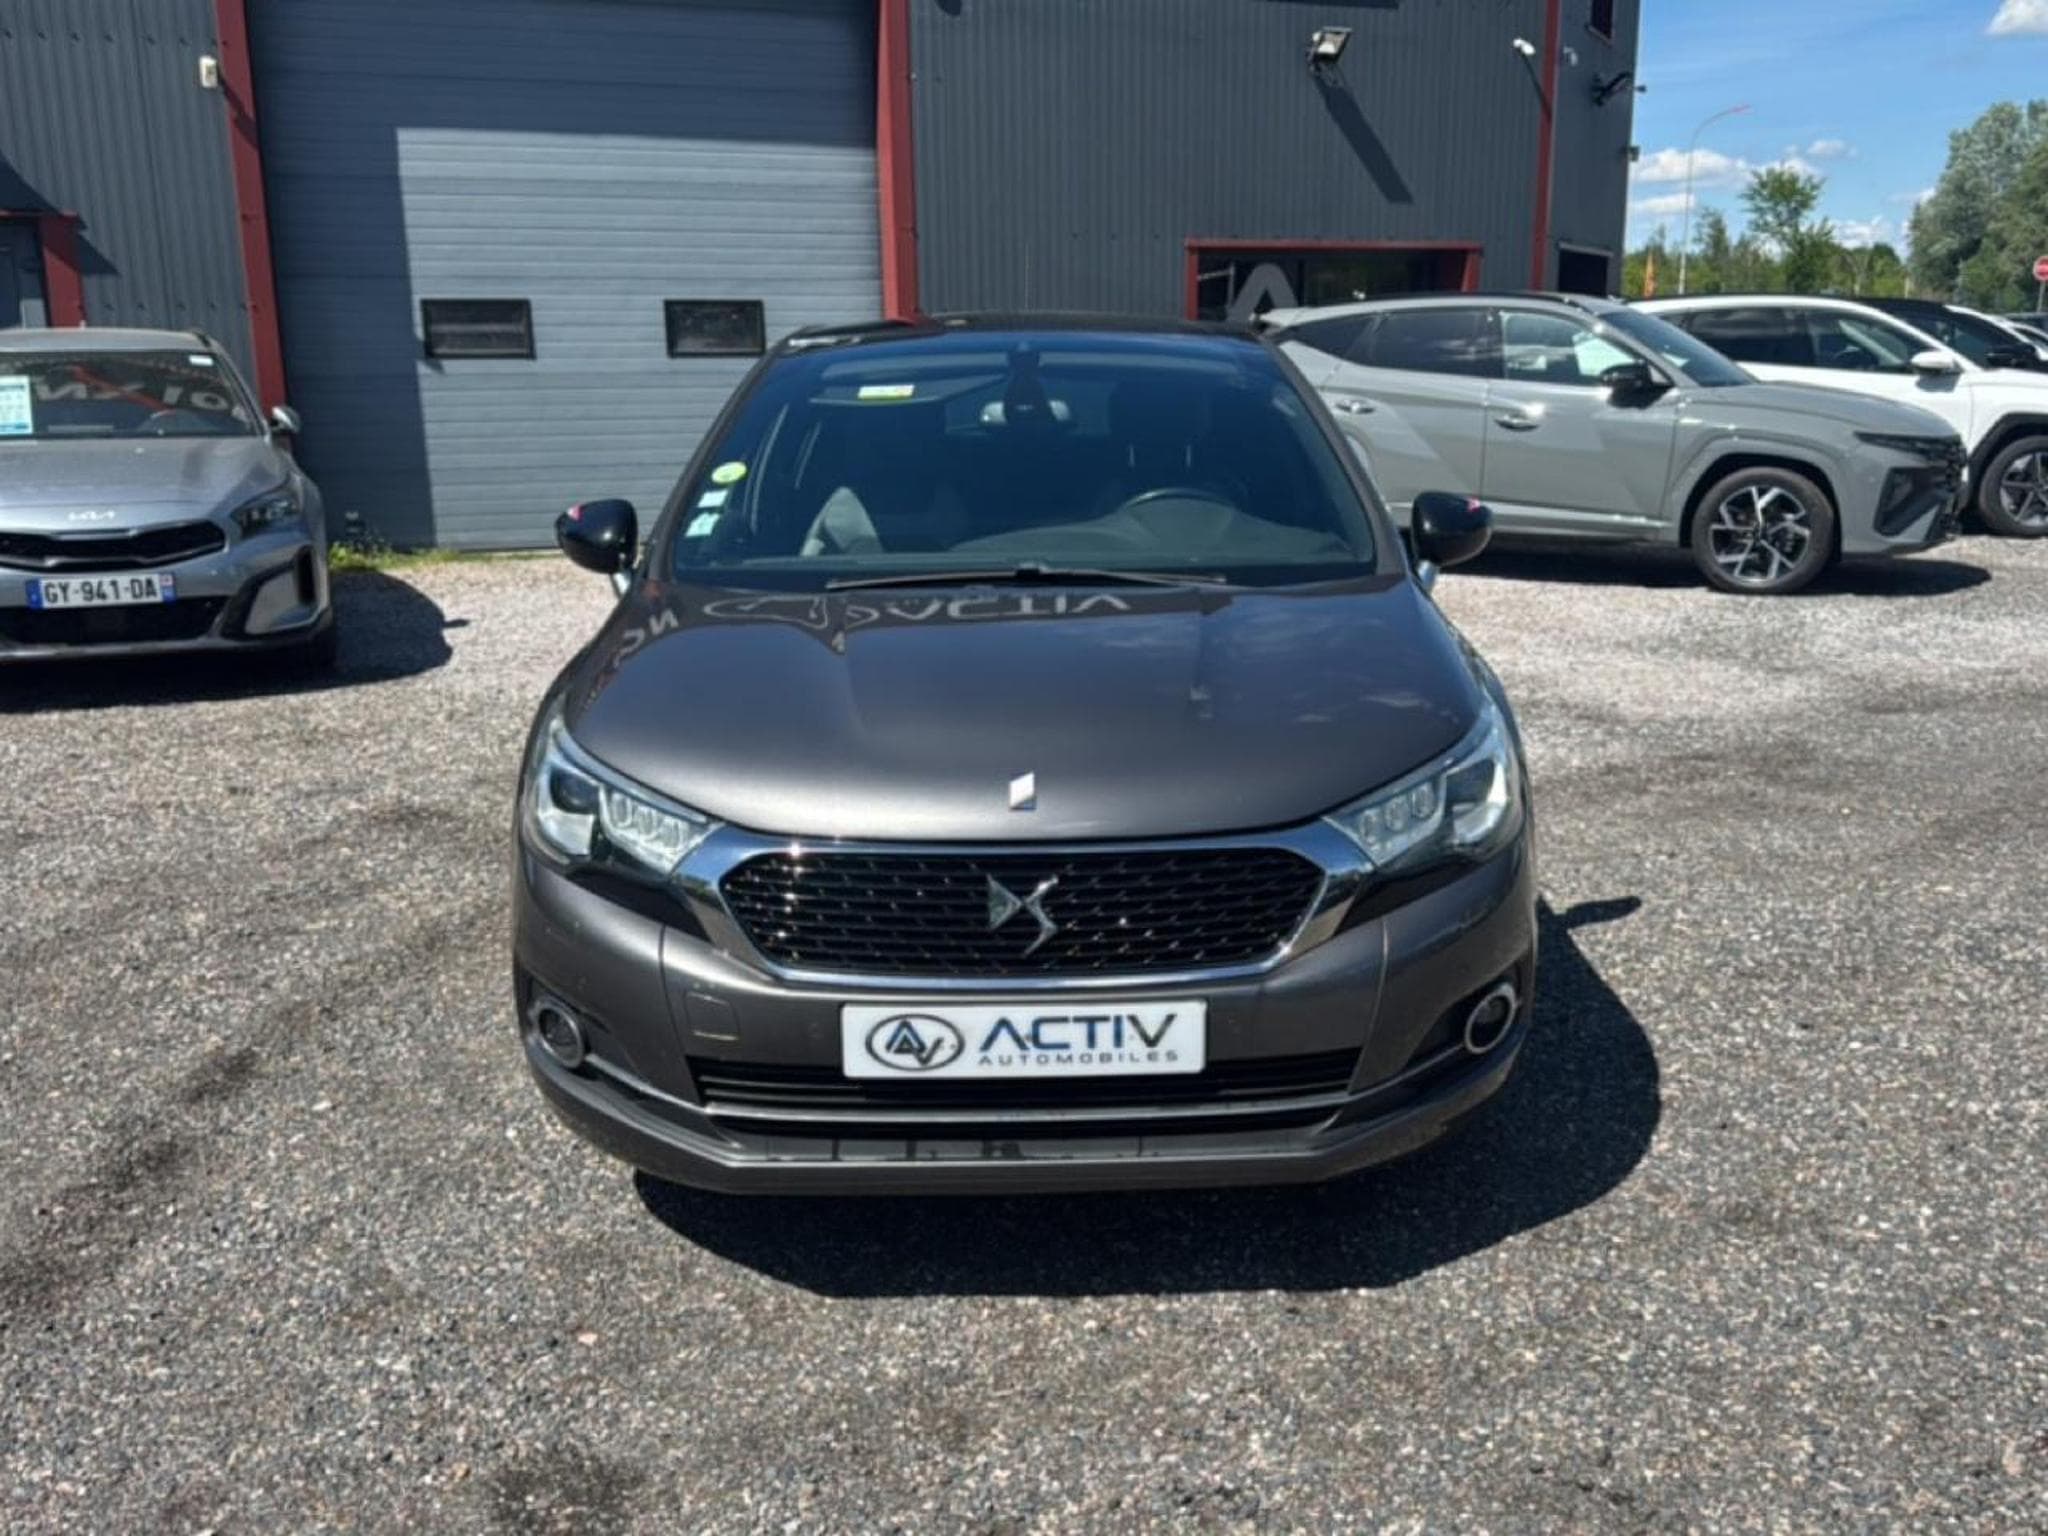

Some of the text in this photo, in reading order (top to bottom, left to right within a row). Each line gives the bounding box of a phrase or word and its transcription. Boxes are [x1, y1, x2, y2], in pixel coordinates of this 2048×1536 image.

[44, 577, 158, 605] GY-941-DA
[979, 1013, 1178, 1051] ACTIV
[977, 1052, 1179, 1067] AUTOMOBILES
